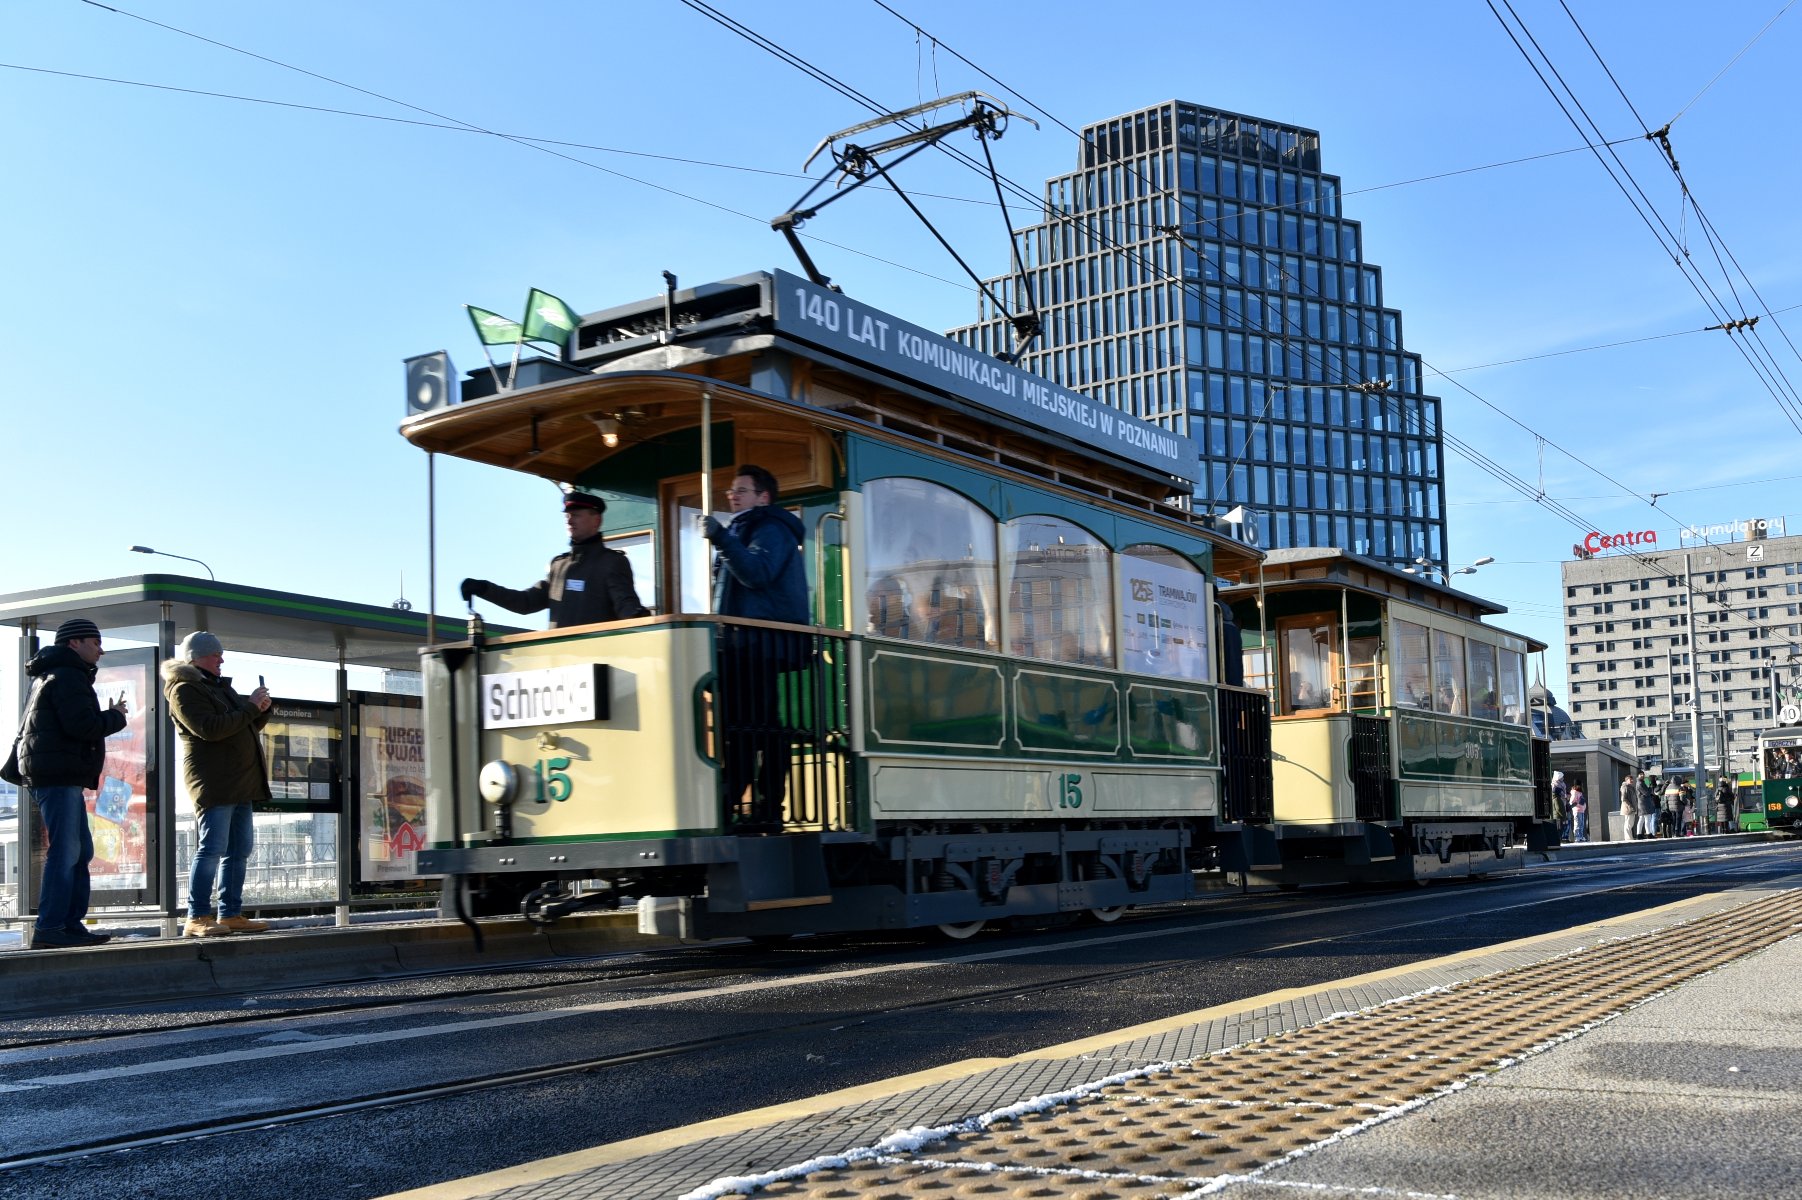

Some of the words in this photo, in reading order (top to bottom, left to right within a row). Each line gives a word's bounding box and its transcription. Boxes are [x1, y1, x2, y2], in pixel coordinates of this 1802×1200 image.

[408, 357, 442, 411] 6
[795, 288, 840, 333] 140
[847, 308, 889, 352] LAT
[897, 329, 1016, 398] KOMUNIKACJI
[1022, 379, 1097, 429] MIEJSKIEJ
[1099, 418, 1113, 436] W
[1117, 419, 1178, 461] POZNANIU
[1243, 511, 1258, 544] 6
[1584, 530, 1657, 553] Centra
[1681, 516, 1784, 538] akumulatory
[273, 708, 312, 718] Kaponiera
[1783, 708, 1796, 721] 10
[533, 757, 573, 804] 15
[1058, 773, 1083, 809] 15
[1768, 802, 1782, 811] 158
